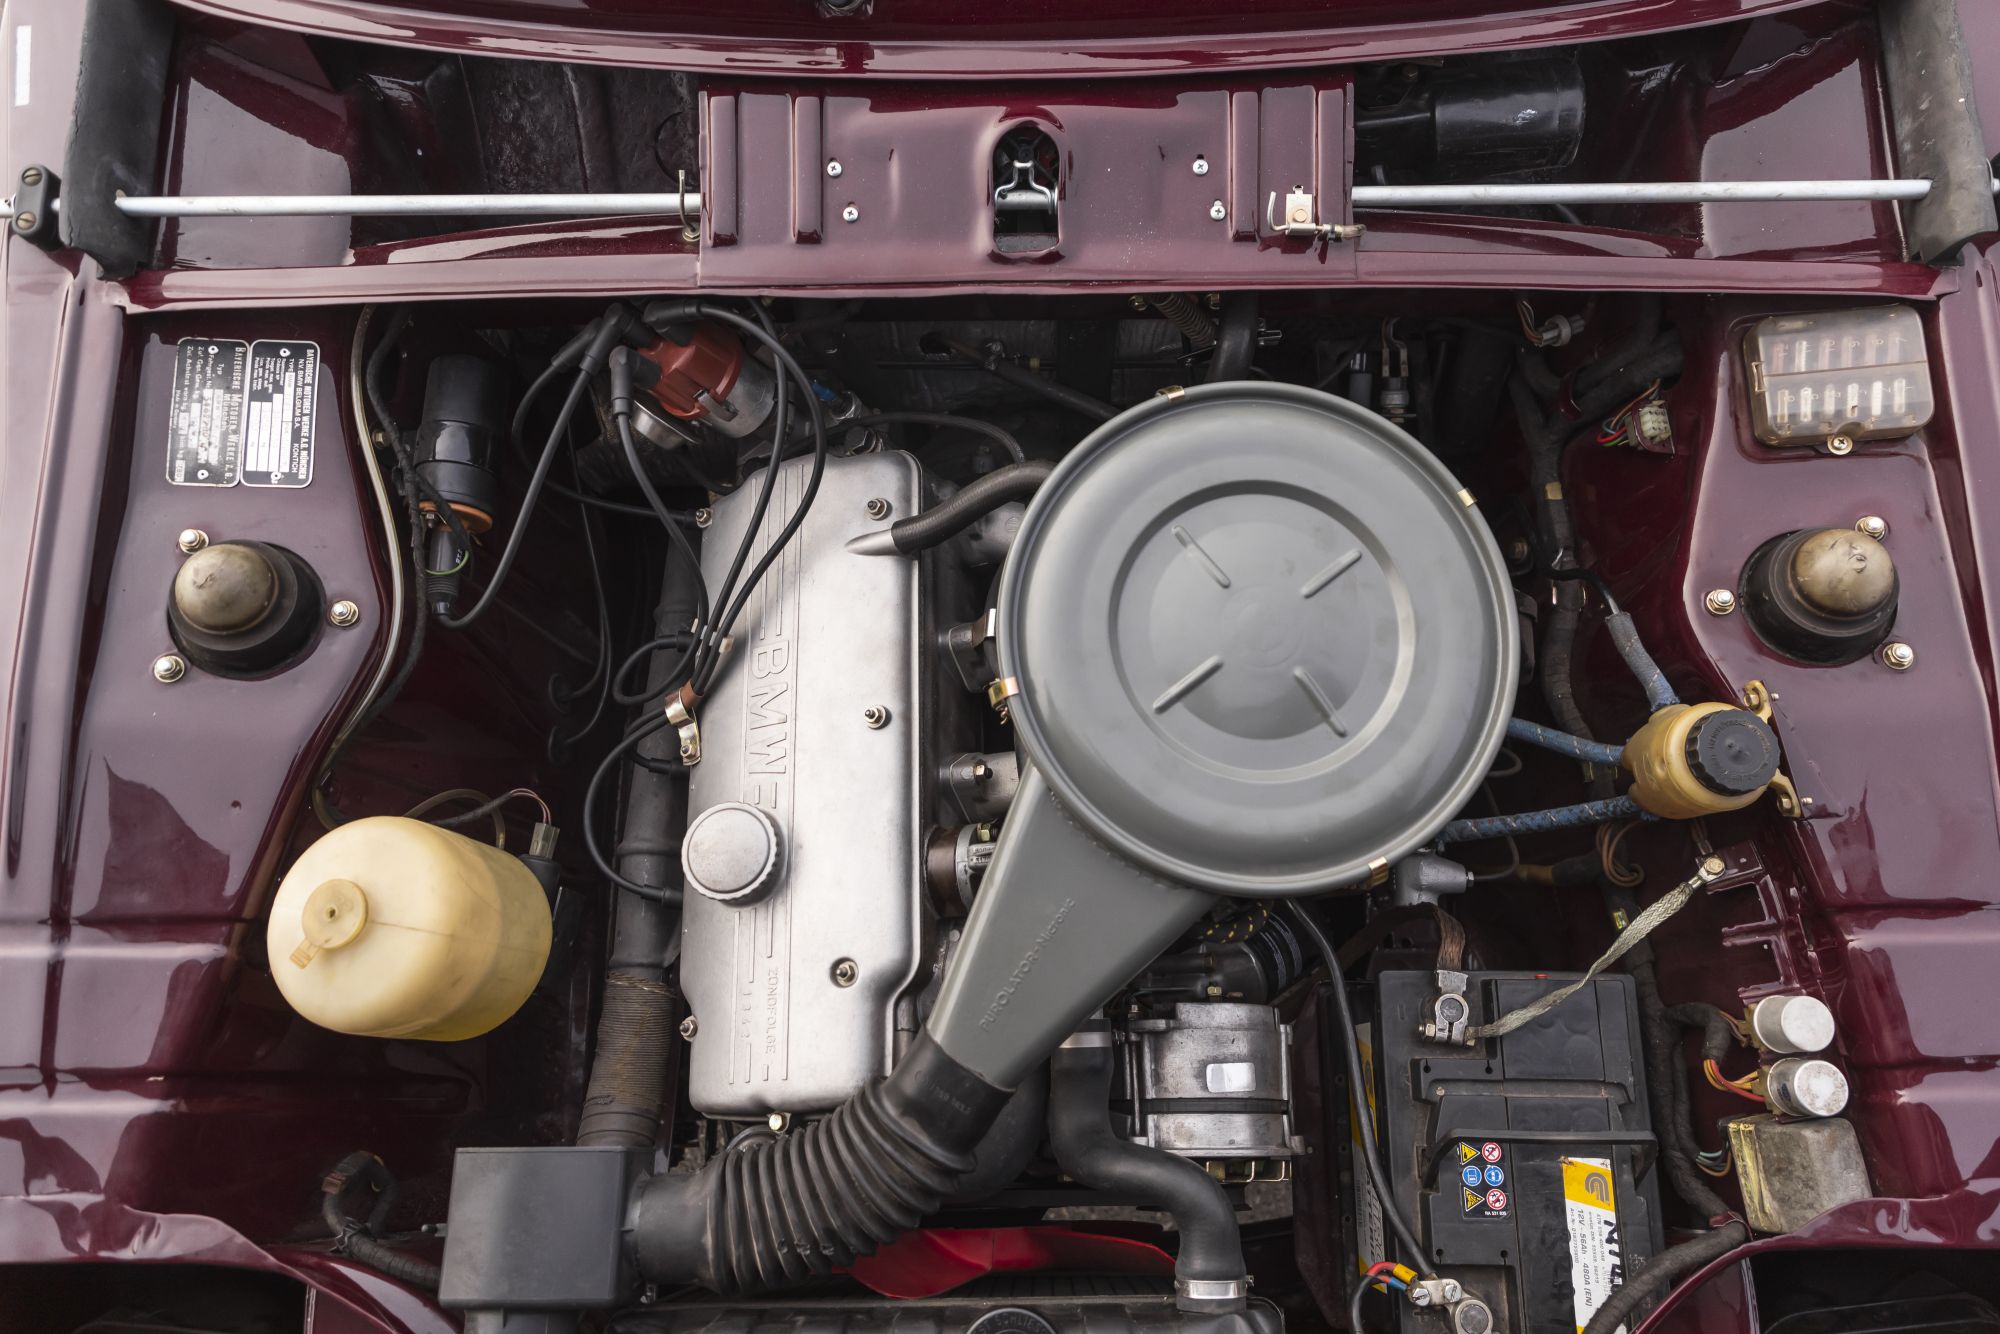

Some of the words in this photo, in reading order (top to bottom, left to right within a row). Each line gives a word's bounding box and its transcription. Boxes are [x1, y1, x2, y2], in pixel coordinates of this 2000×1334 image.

[216, 364, 224, 374] Typ
[304, 348, 315, 384] BAYERISCHE
[296, 370, 304, 387] BMW
[295, 387, 303, 416] BELGIUM
[302, 386, 312, 414] MOTOREN
[300, 416, 310, 437] WERKE
[291, 443, 300, 473] KONTICH
[748, 640, 790, 775] BMW
[1577, 1208, 1586, 1226] 12V
[1580, 1233, 1588, 1255] 56Ah
[1583, 1262, 1591, 1286] 480A
[1584, 1287, 1592, 1307] (EN)
